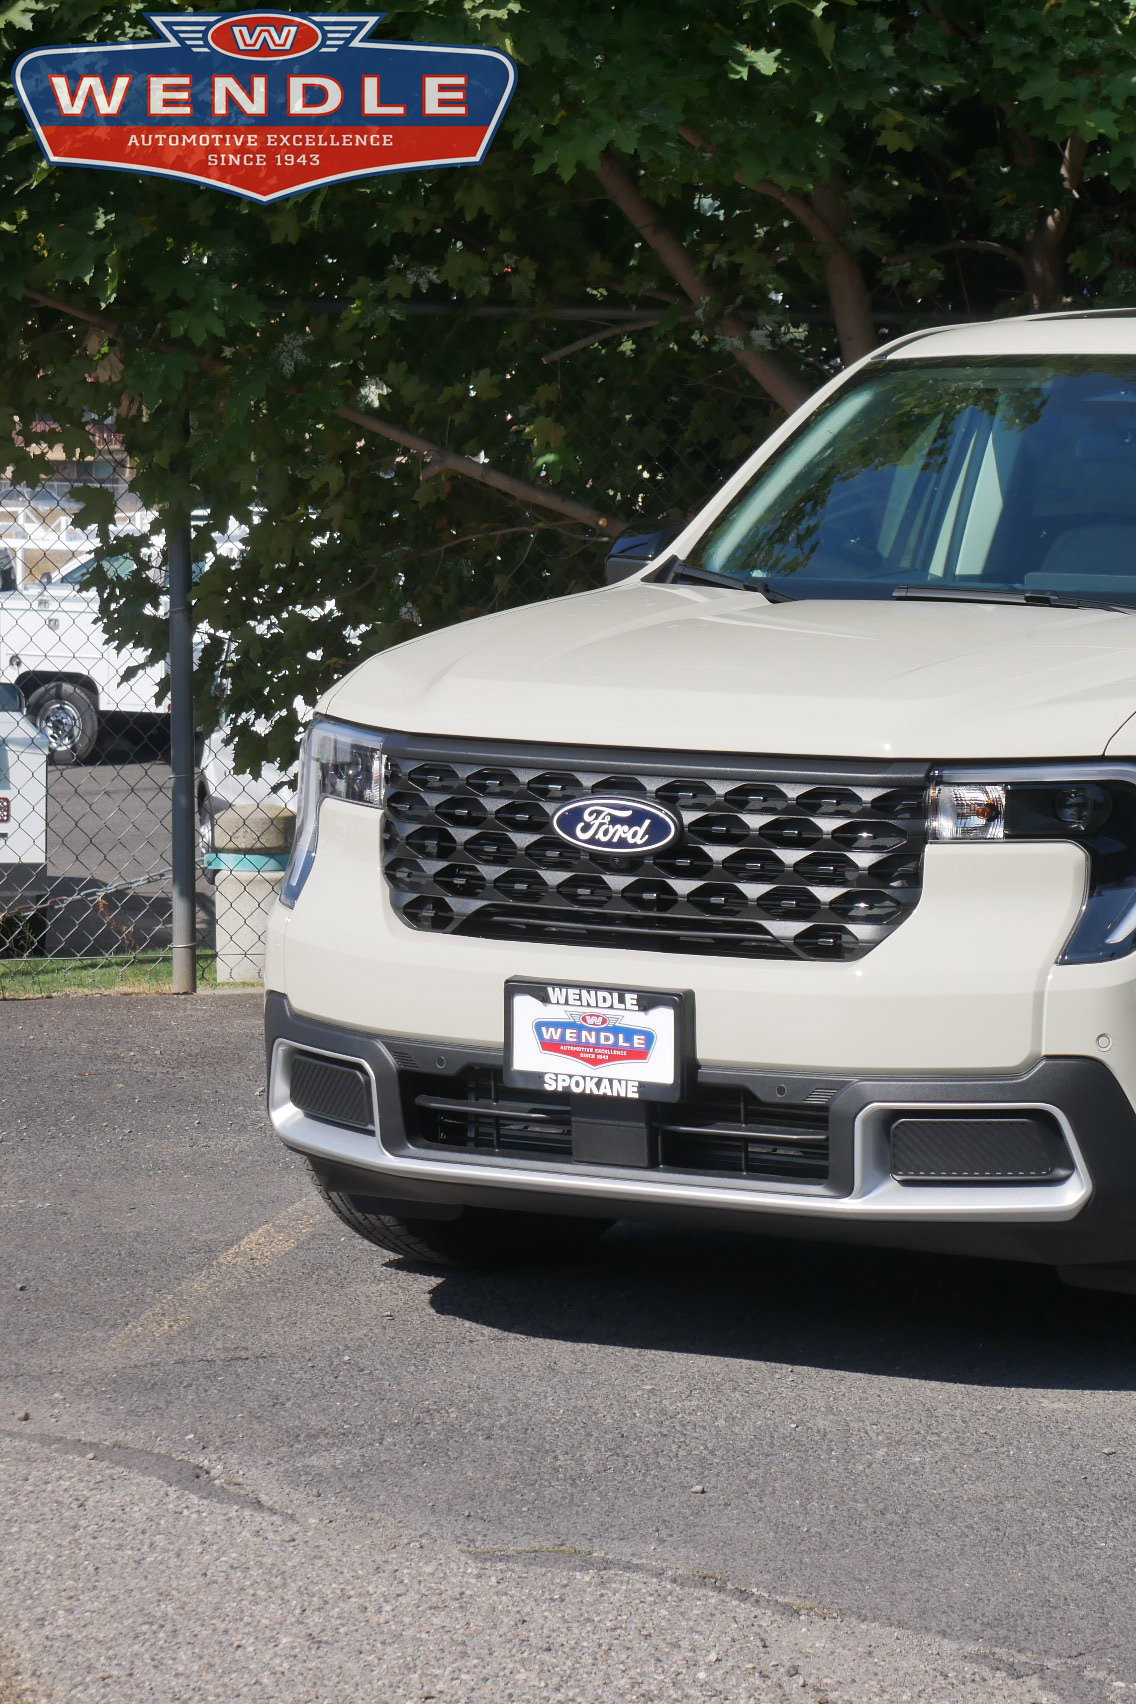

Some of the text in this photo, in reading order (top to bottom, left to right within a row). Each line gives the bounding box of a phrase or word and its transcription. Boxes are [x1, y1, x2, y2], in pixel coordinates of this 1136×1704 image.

[576, 806, 651, 844] Ford
[547, 986, 639, 1011] WENDLE
[541, 1026, 646, 1048] WENDLE
[543, 1073, 639, 1098] SPOKANE
